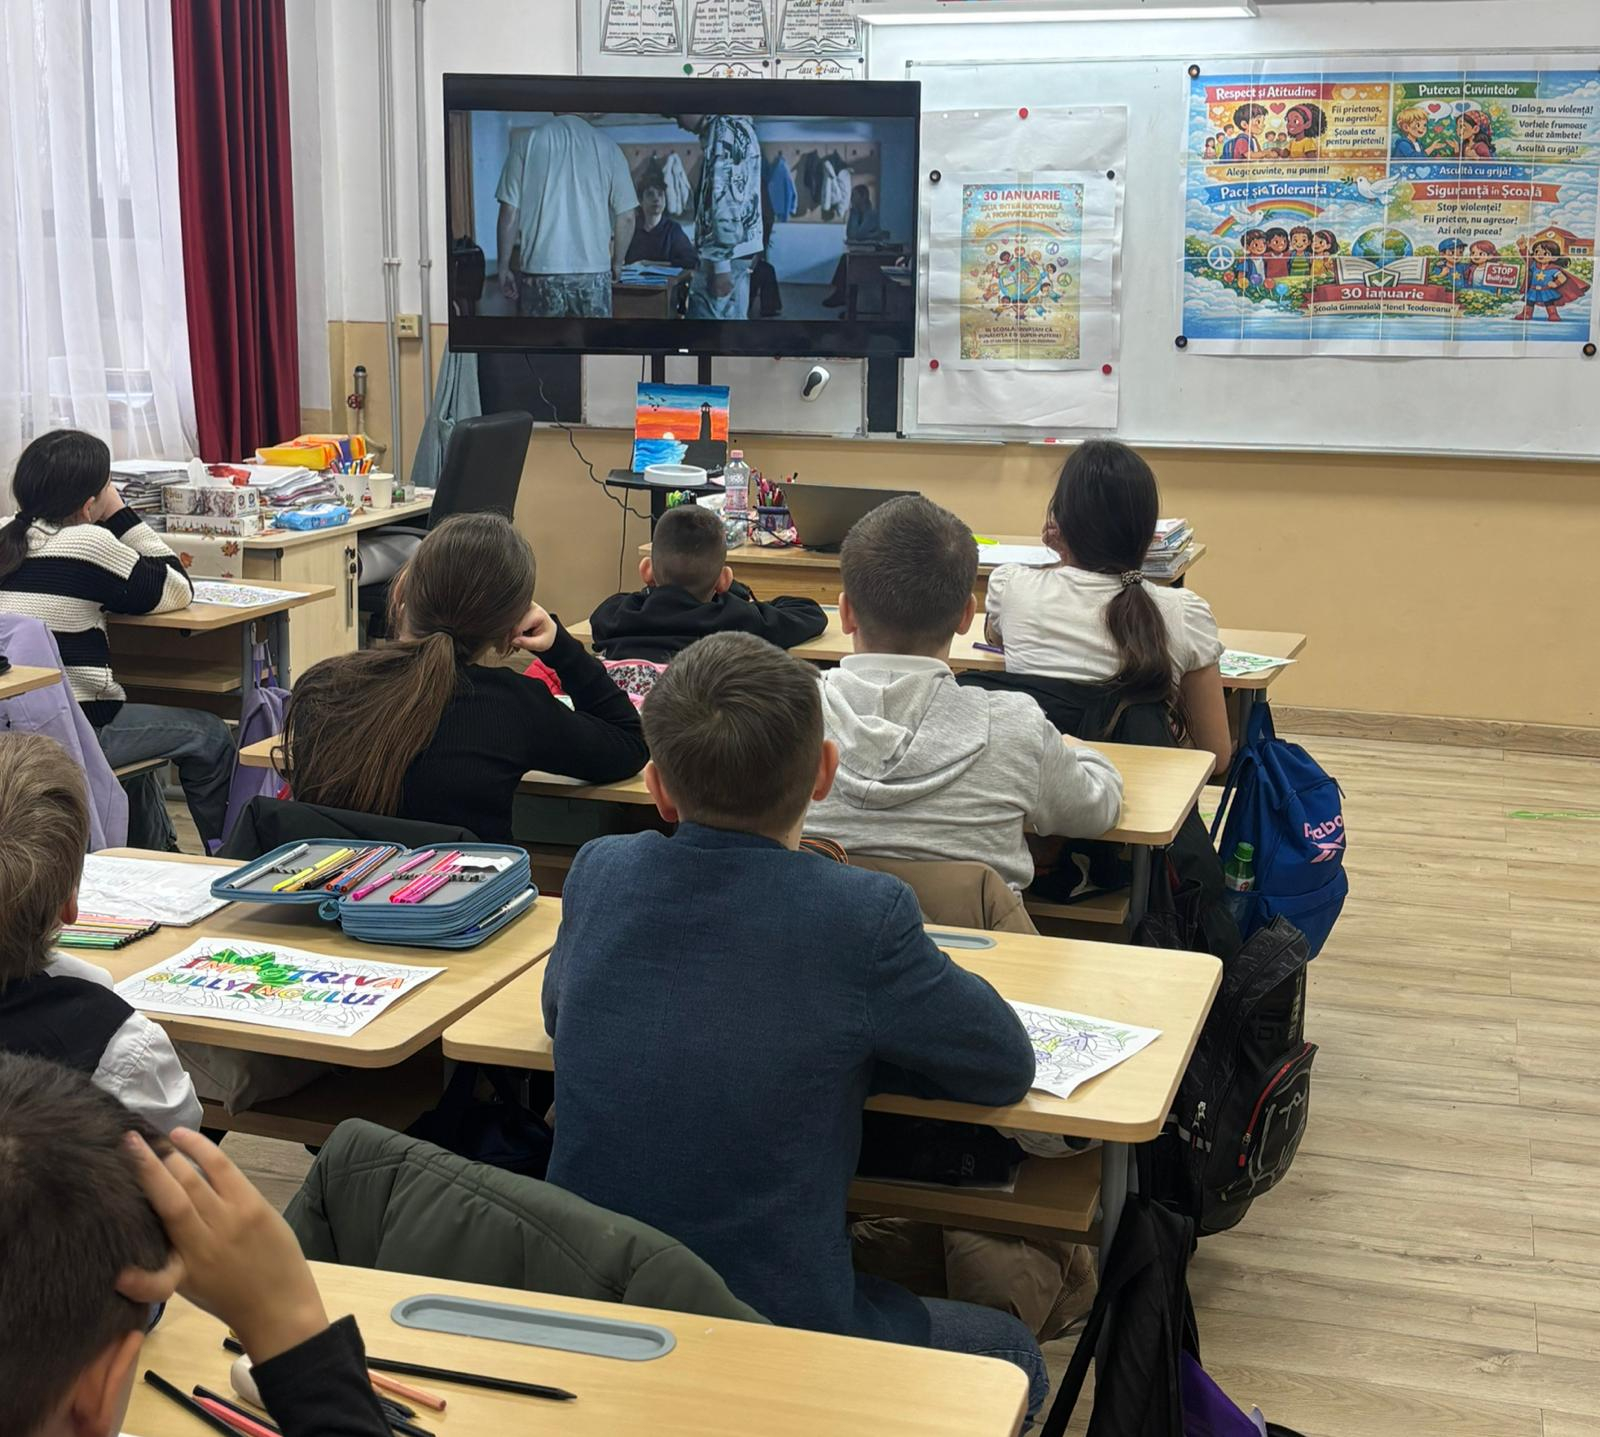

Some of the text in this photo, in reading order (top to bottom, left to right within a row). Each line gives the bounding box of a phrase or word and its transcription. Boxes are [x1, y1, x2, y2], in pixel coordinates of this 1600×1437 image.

[1216, 87, 1256, 100] Respect
[1267, 86, 1317, 98] Atitudine
[1418, 83, 1520, 97] Puterea Cuvintelor
[1331, 104, 1382, 115] Fii prietenos,
[1511, 104, 1544, 115] Dialog,
[1546, 105, 1557, 113] nu
[1345, 114, 1377, 125] agresiv!
[1551, 119, 1588, 129] frumoase
[1360, 128, 1376, 136] este
[1524, 130, 1544, 139] aduc
[1326, 136, 1385, 147] pentru prieteni!
[1251, 166, 1285, 176] cuvinte,
[1286, 167, 1297, 175] nu
[1298, 165, 1330, 177] pumni!
[1439, 165, 1473, 175] Ascultă
[1474, 166, 1485, 175] cu
[983, 190, 1061, 200] 30 IANUARIE
[1220, 186, 1249, 199] Pace
[1268, 183, 1328, 198] Toleranță
[1426, 184, 1489, 199] Siguranță
[1501, 184, 1543, 199] Școală
[1437, 202, 1502, 214] Stop violenței!
[1423, 215, 1519, 226] Fii prieten, nu agresor!
[1437, 226, 1451, 236] Azi
[1473, 227, 1503, 237] pacea!
[1491, 266, 1513, 275] STOP
[1341, 287, 1425, 300] 30 ianuarie
[146, 973, 384, 1005] BULLYINGULUI
